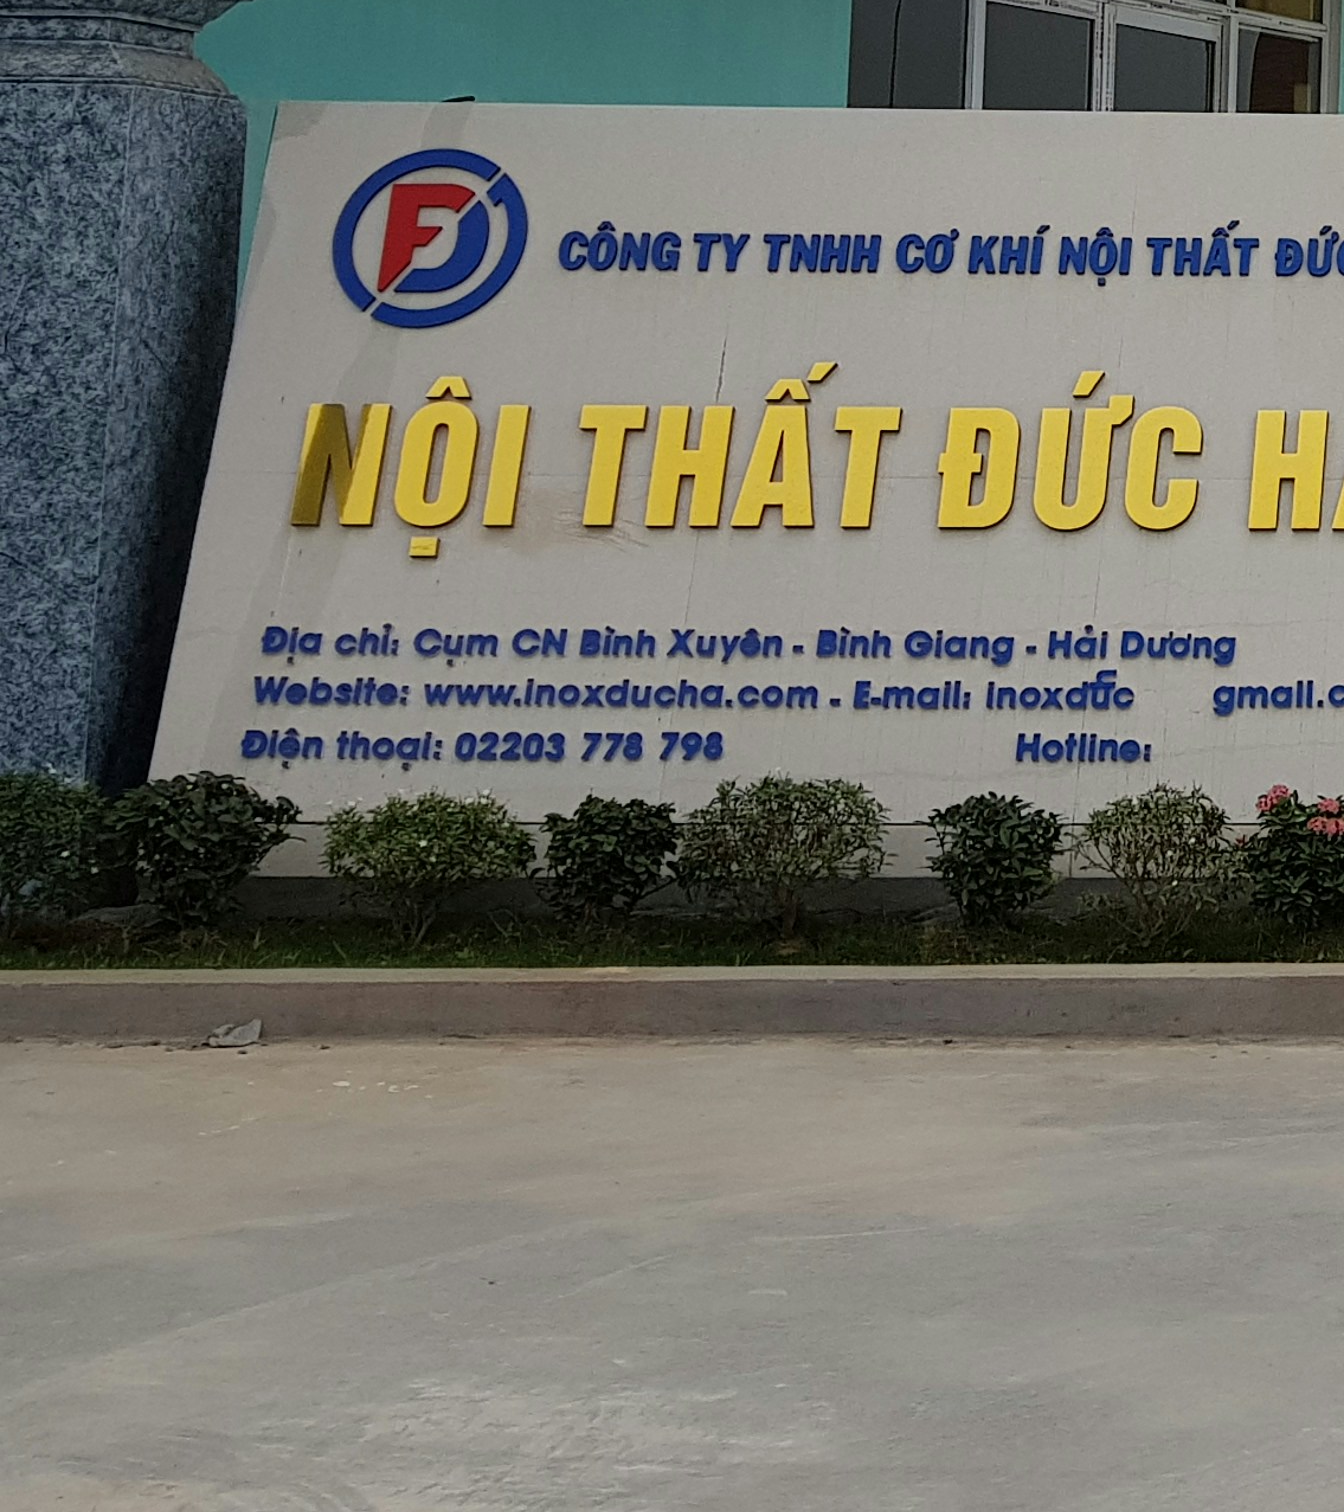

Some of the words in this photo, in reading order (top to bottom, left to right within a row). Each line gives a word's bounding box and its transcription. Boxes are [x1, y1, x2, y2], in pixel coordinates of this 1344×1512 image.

[559, 221, 681, 272] CÔNG
[693, 233, 750, 273] TY
[764, 234, 882, 273] TNHH
[896, 228, 960, 274] CƠ
[968, 224, 1051, 275] KHÍ
[1059, 226, 1132, 286] NỘI
[1147, 220, 1260, 277] THẤT
[290, 375, 532, 558] NỘI
[579, 360, 903, 529] THẤT
[937, 369, 1204, 531] ĐỨC
[261, 625, 324, 666] Địa
[334, 622, 400, 657] chỉ:
[413, 627, 499, 668] Cụm
[512, 628, 569, 658] CN
[579, 625, 656, 658] Bình
[666, 627, 783, 664] Xuyên
[816, 625, 892, 658] Bình
[904, 629, 1015, 667] Giang
[1047, 624, 1109, 660] Hải
[1120, 629, 1237, 667] Dương
[253, 675, 410, 707] Website:
[423, 678, 819, 709] www.inoxducha.com
[853, 679, 971, 710] E-mail:
[240, 727, 324, 770] Điện
[337, 730, 443, 772] thoại:
[454, 731, 566, 762] 02203
[580, 731, 644, 762] 778
[659, 731, 724, 762] 798
[1015, 732, 1152, 763] Hotline:
